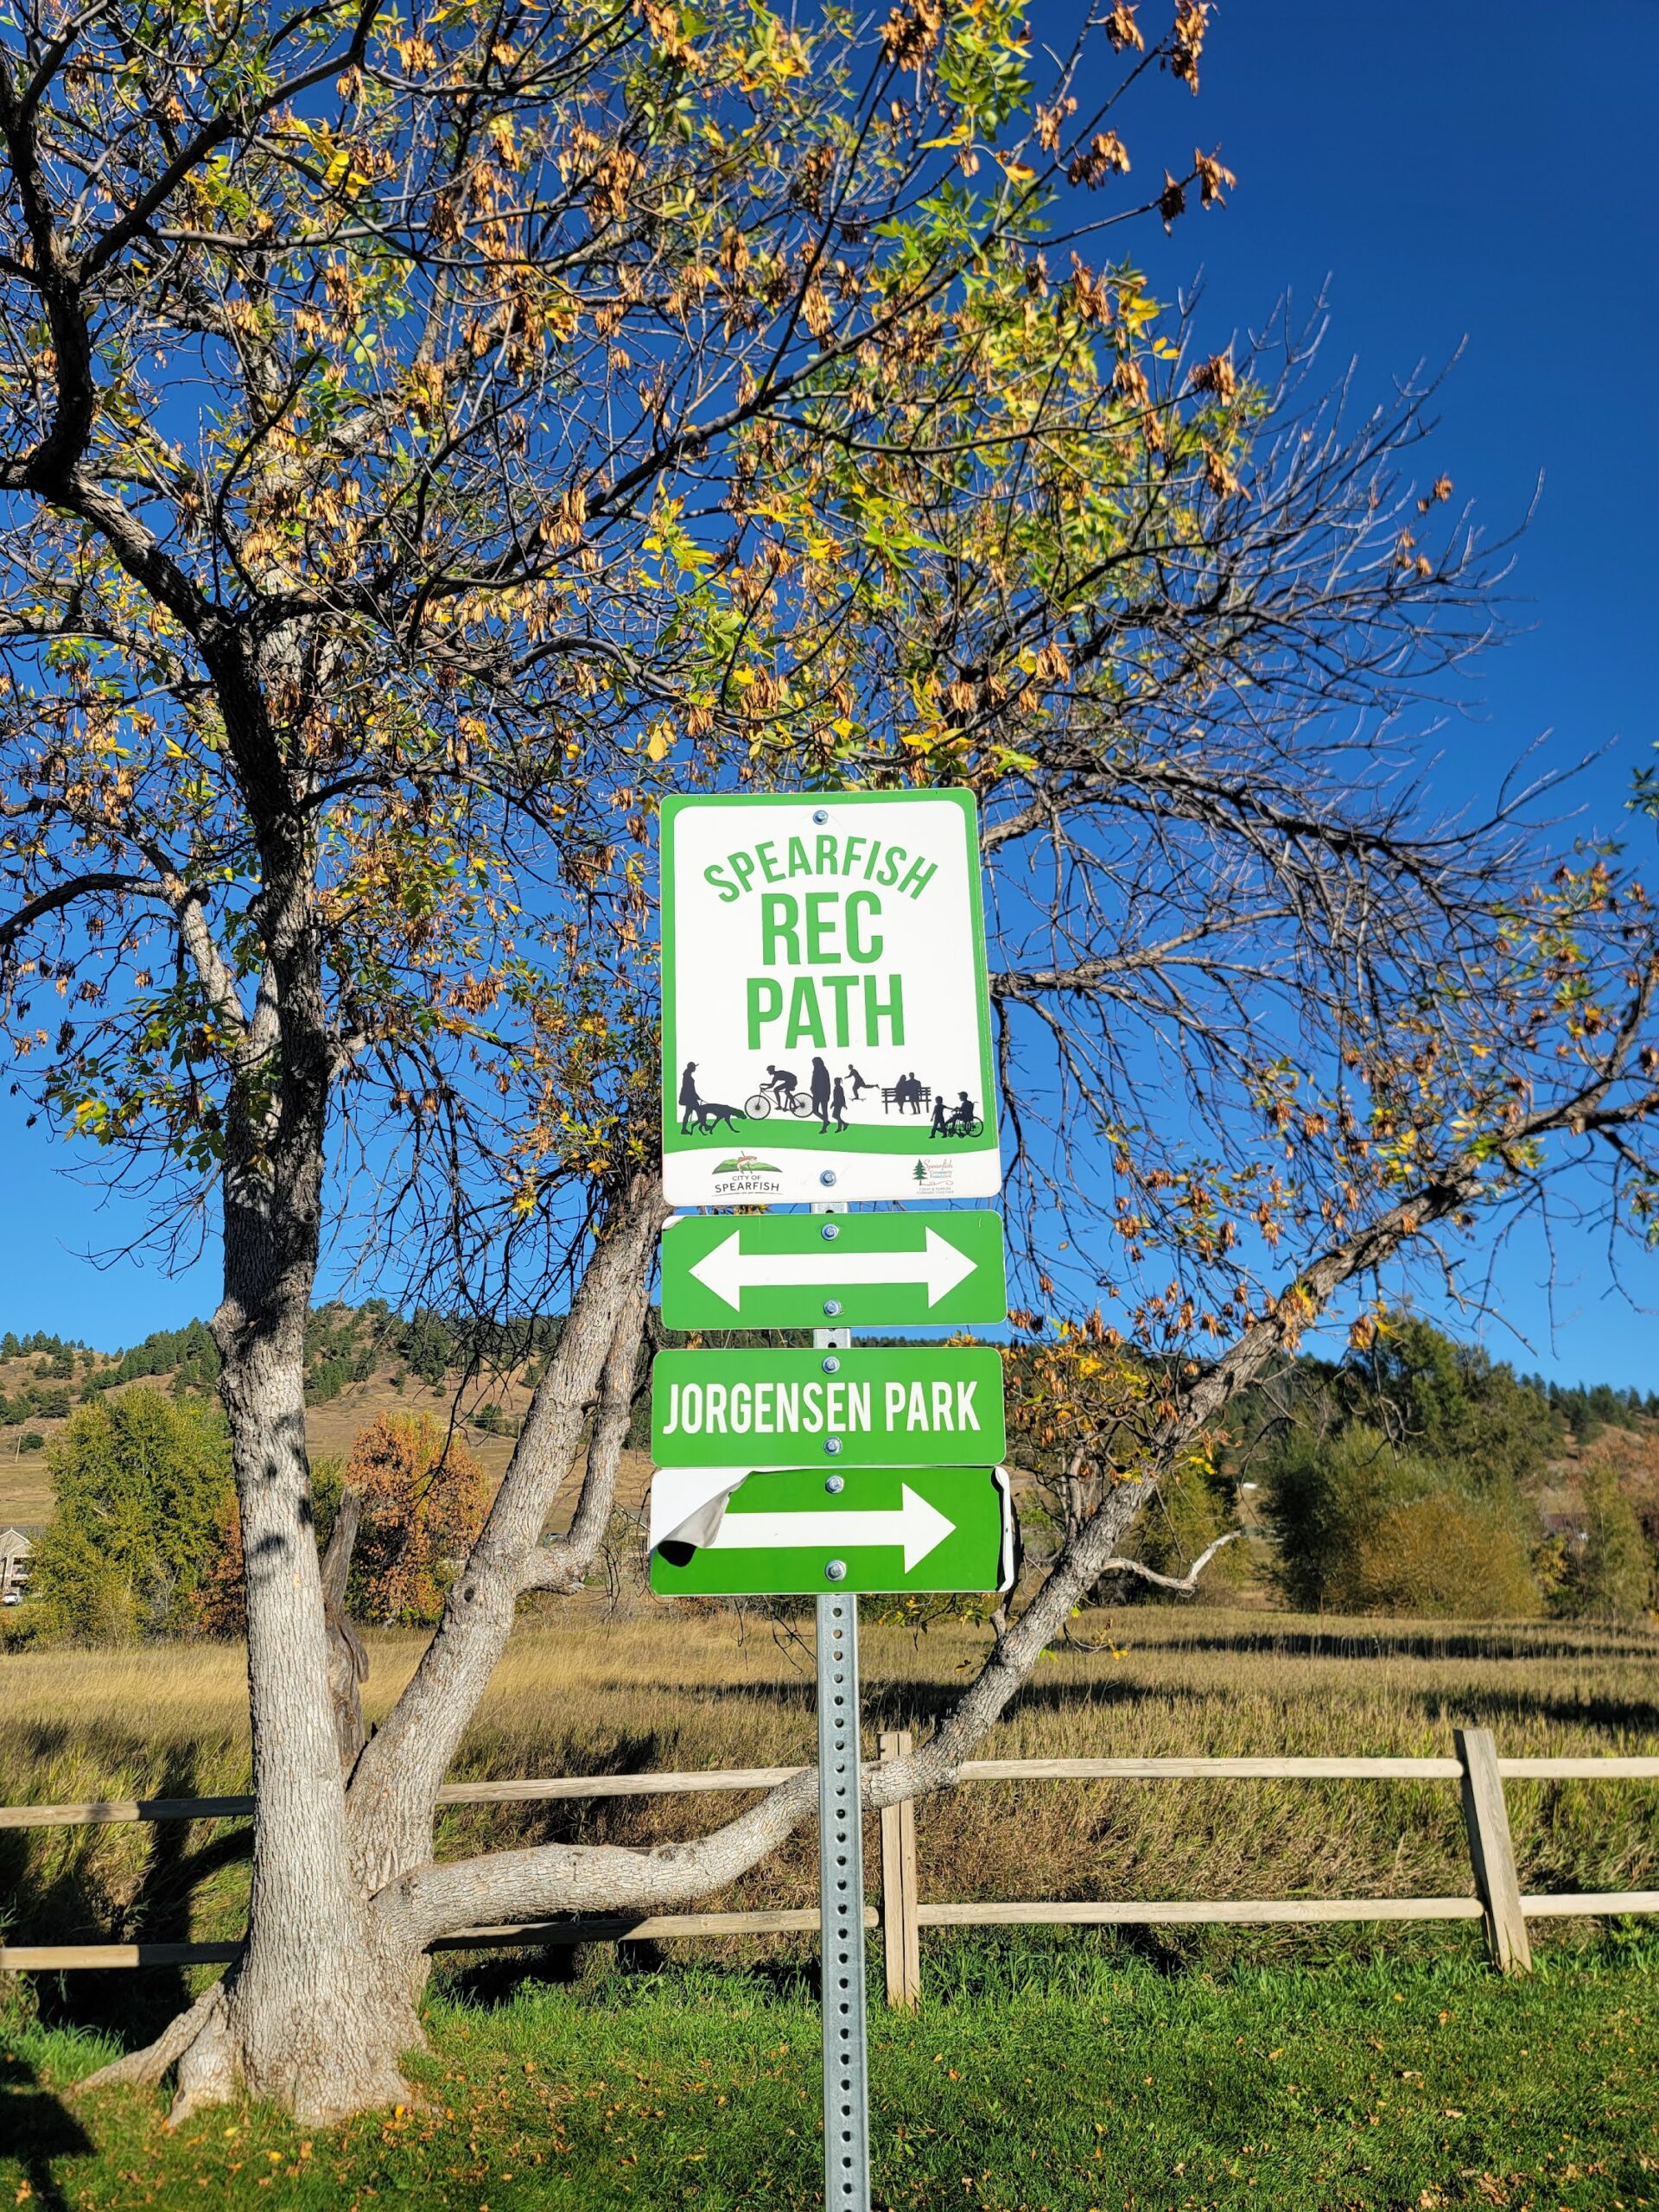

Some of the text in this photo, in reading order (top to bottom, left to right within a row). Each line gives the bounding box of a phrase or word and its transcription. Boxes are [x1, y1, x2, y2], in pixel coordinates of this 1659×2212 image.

[704, 835, 938, 902] SPEARFISH
[761, 891, 883, 965] REC
[747, 974, 905, 1050] PATH
[715, 1181, 779, 1193] SPEARFISH
[663, 1381, 981, 1435] JORGENSEN PARK
